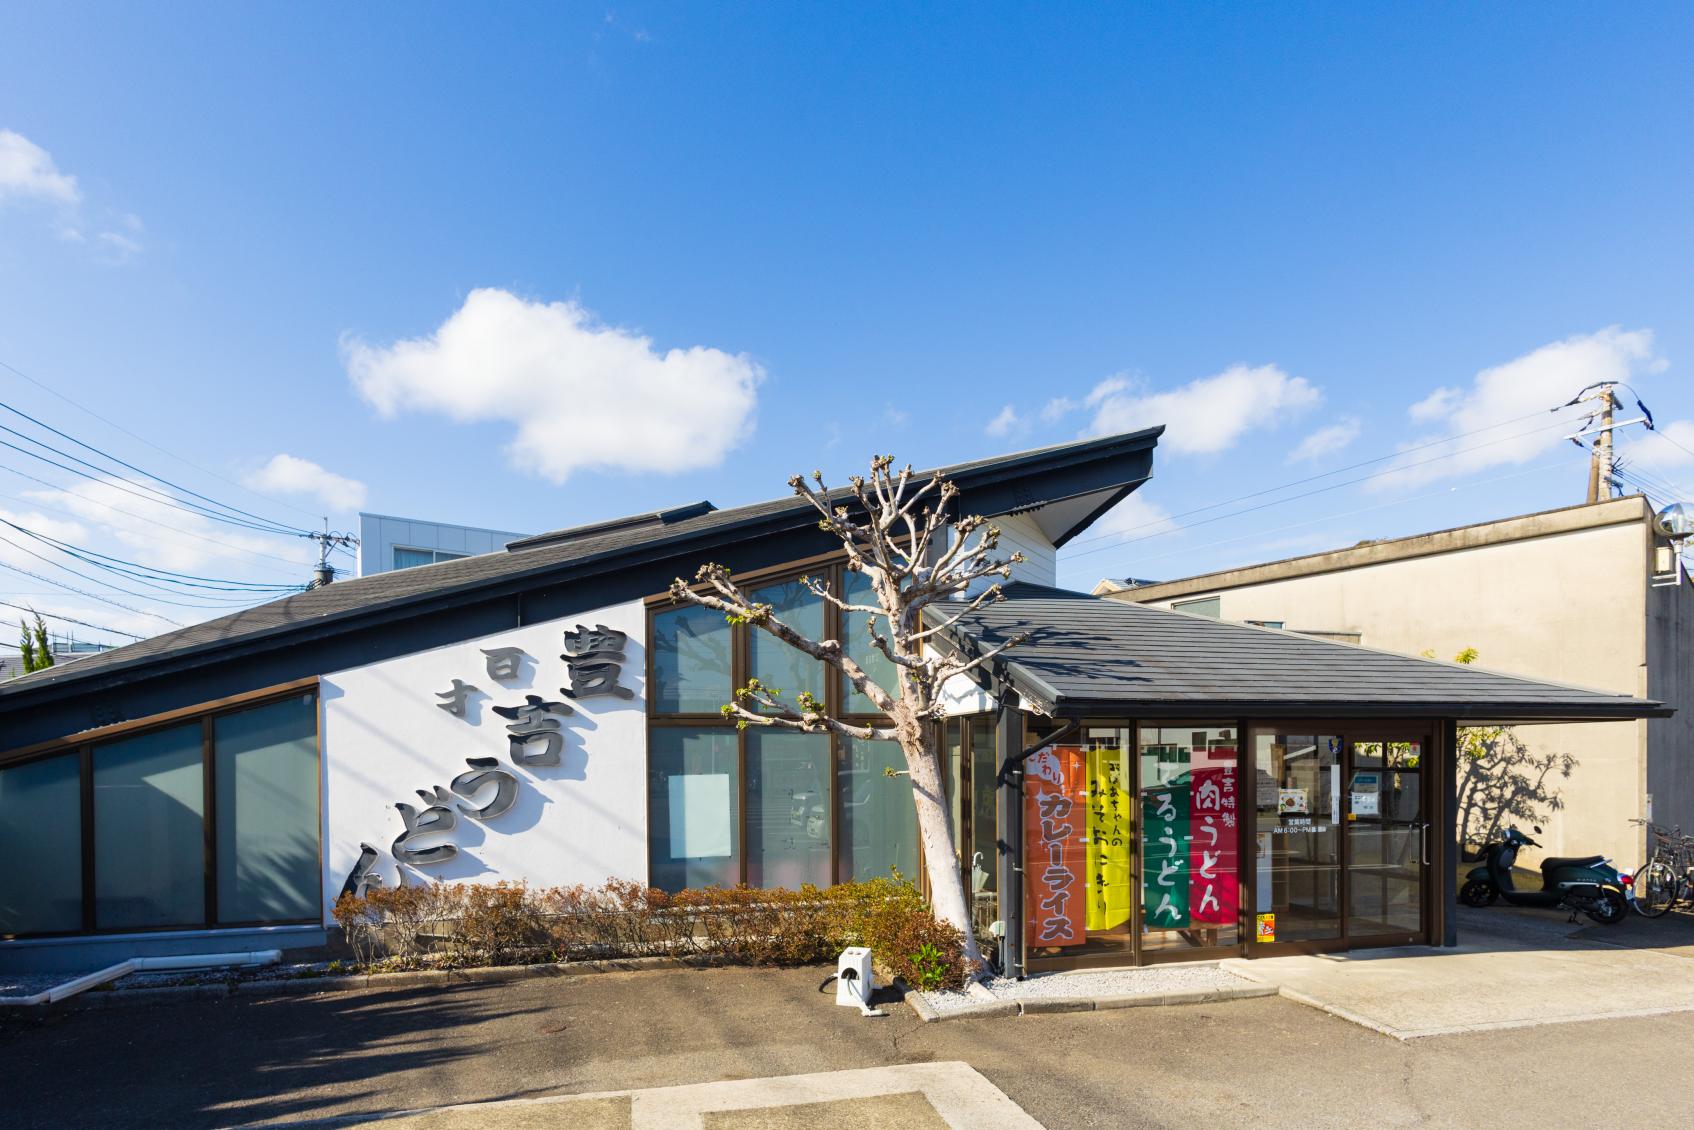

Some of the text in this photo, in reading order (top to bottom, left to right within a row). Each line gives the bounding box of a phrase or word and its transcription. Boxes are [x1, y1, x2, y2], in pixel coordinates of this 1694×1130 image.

[1040, 793, 1075, 940] カレーライス
[1196, 780, 1220, 913] 肉うどん
